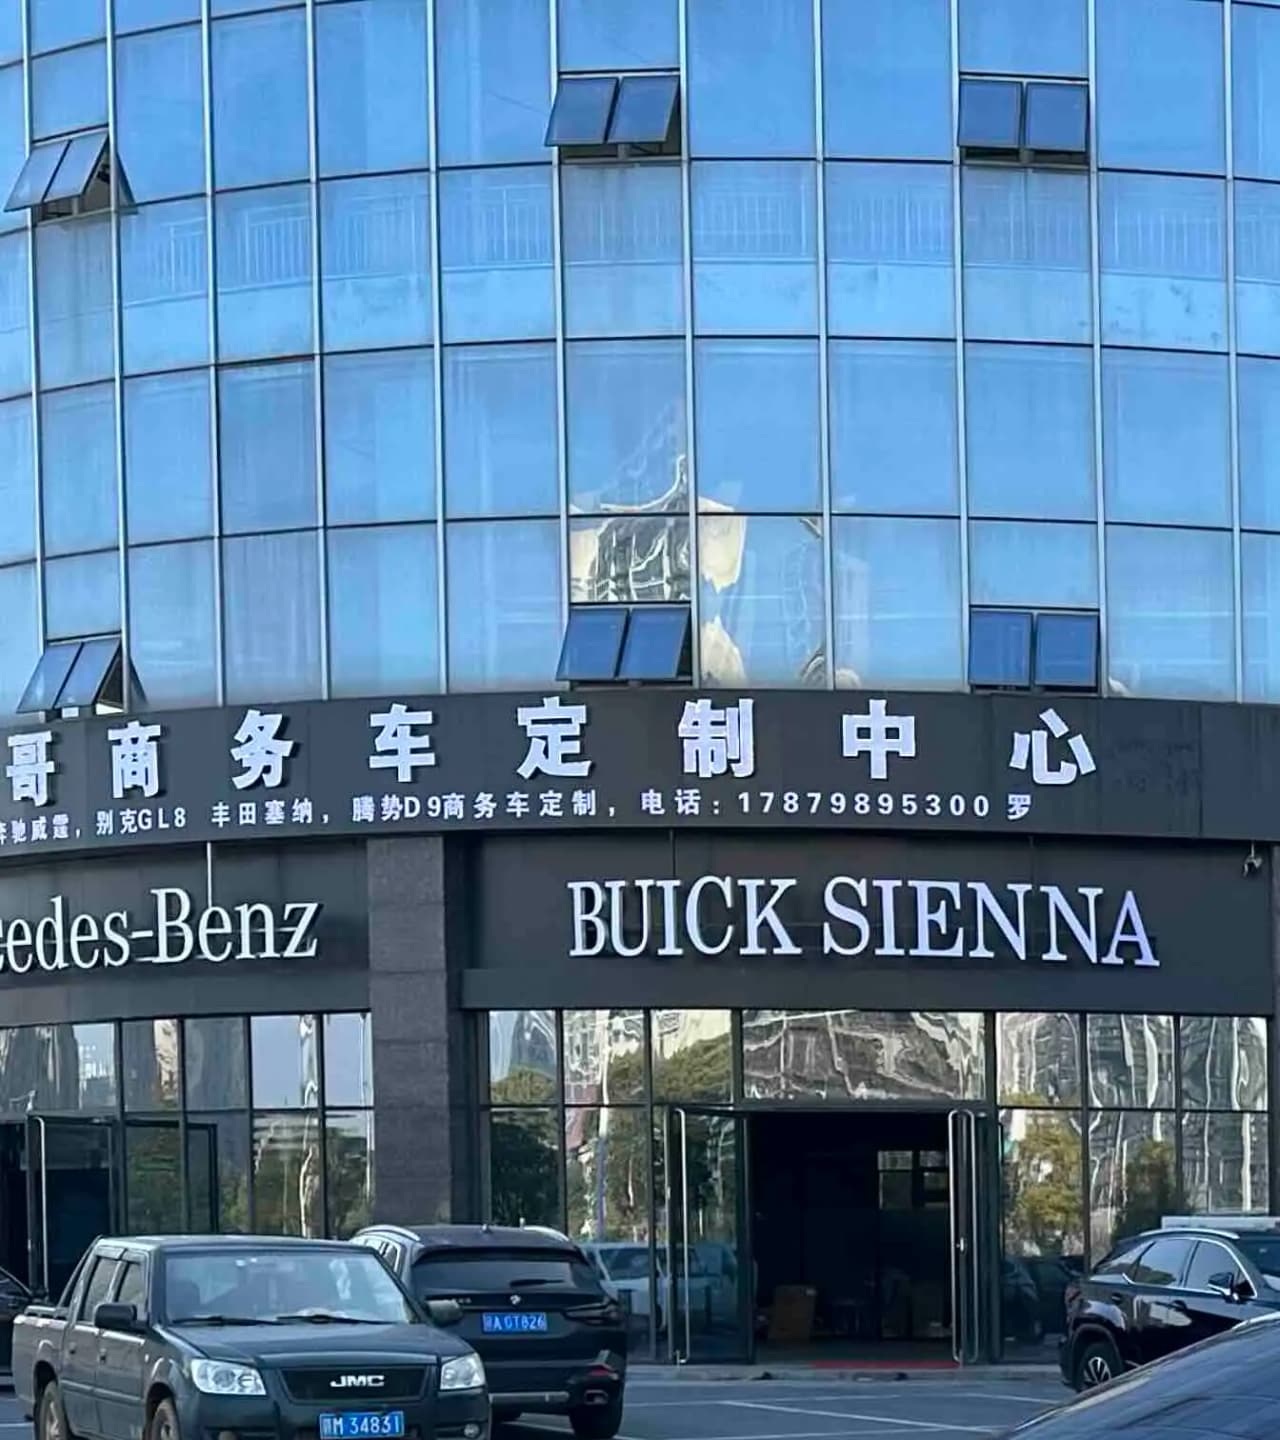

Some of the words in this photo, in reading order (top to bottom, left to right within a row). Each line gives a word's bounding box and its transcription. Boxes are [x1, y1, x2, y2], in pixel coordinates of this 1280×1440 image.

[0, 887, 319, 974] edes-Benz
[567, 875, 802, 957] BUICK
[822, 876, 1160, 967] SIENNA
[329, 1375, 385, 1388] JMC
